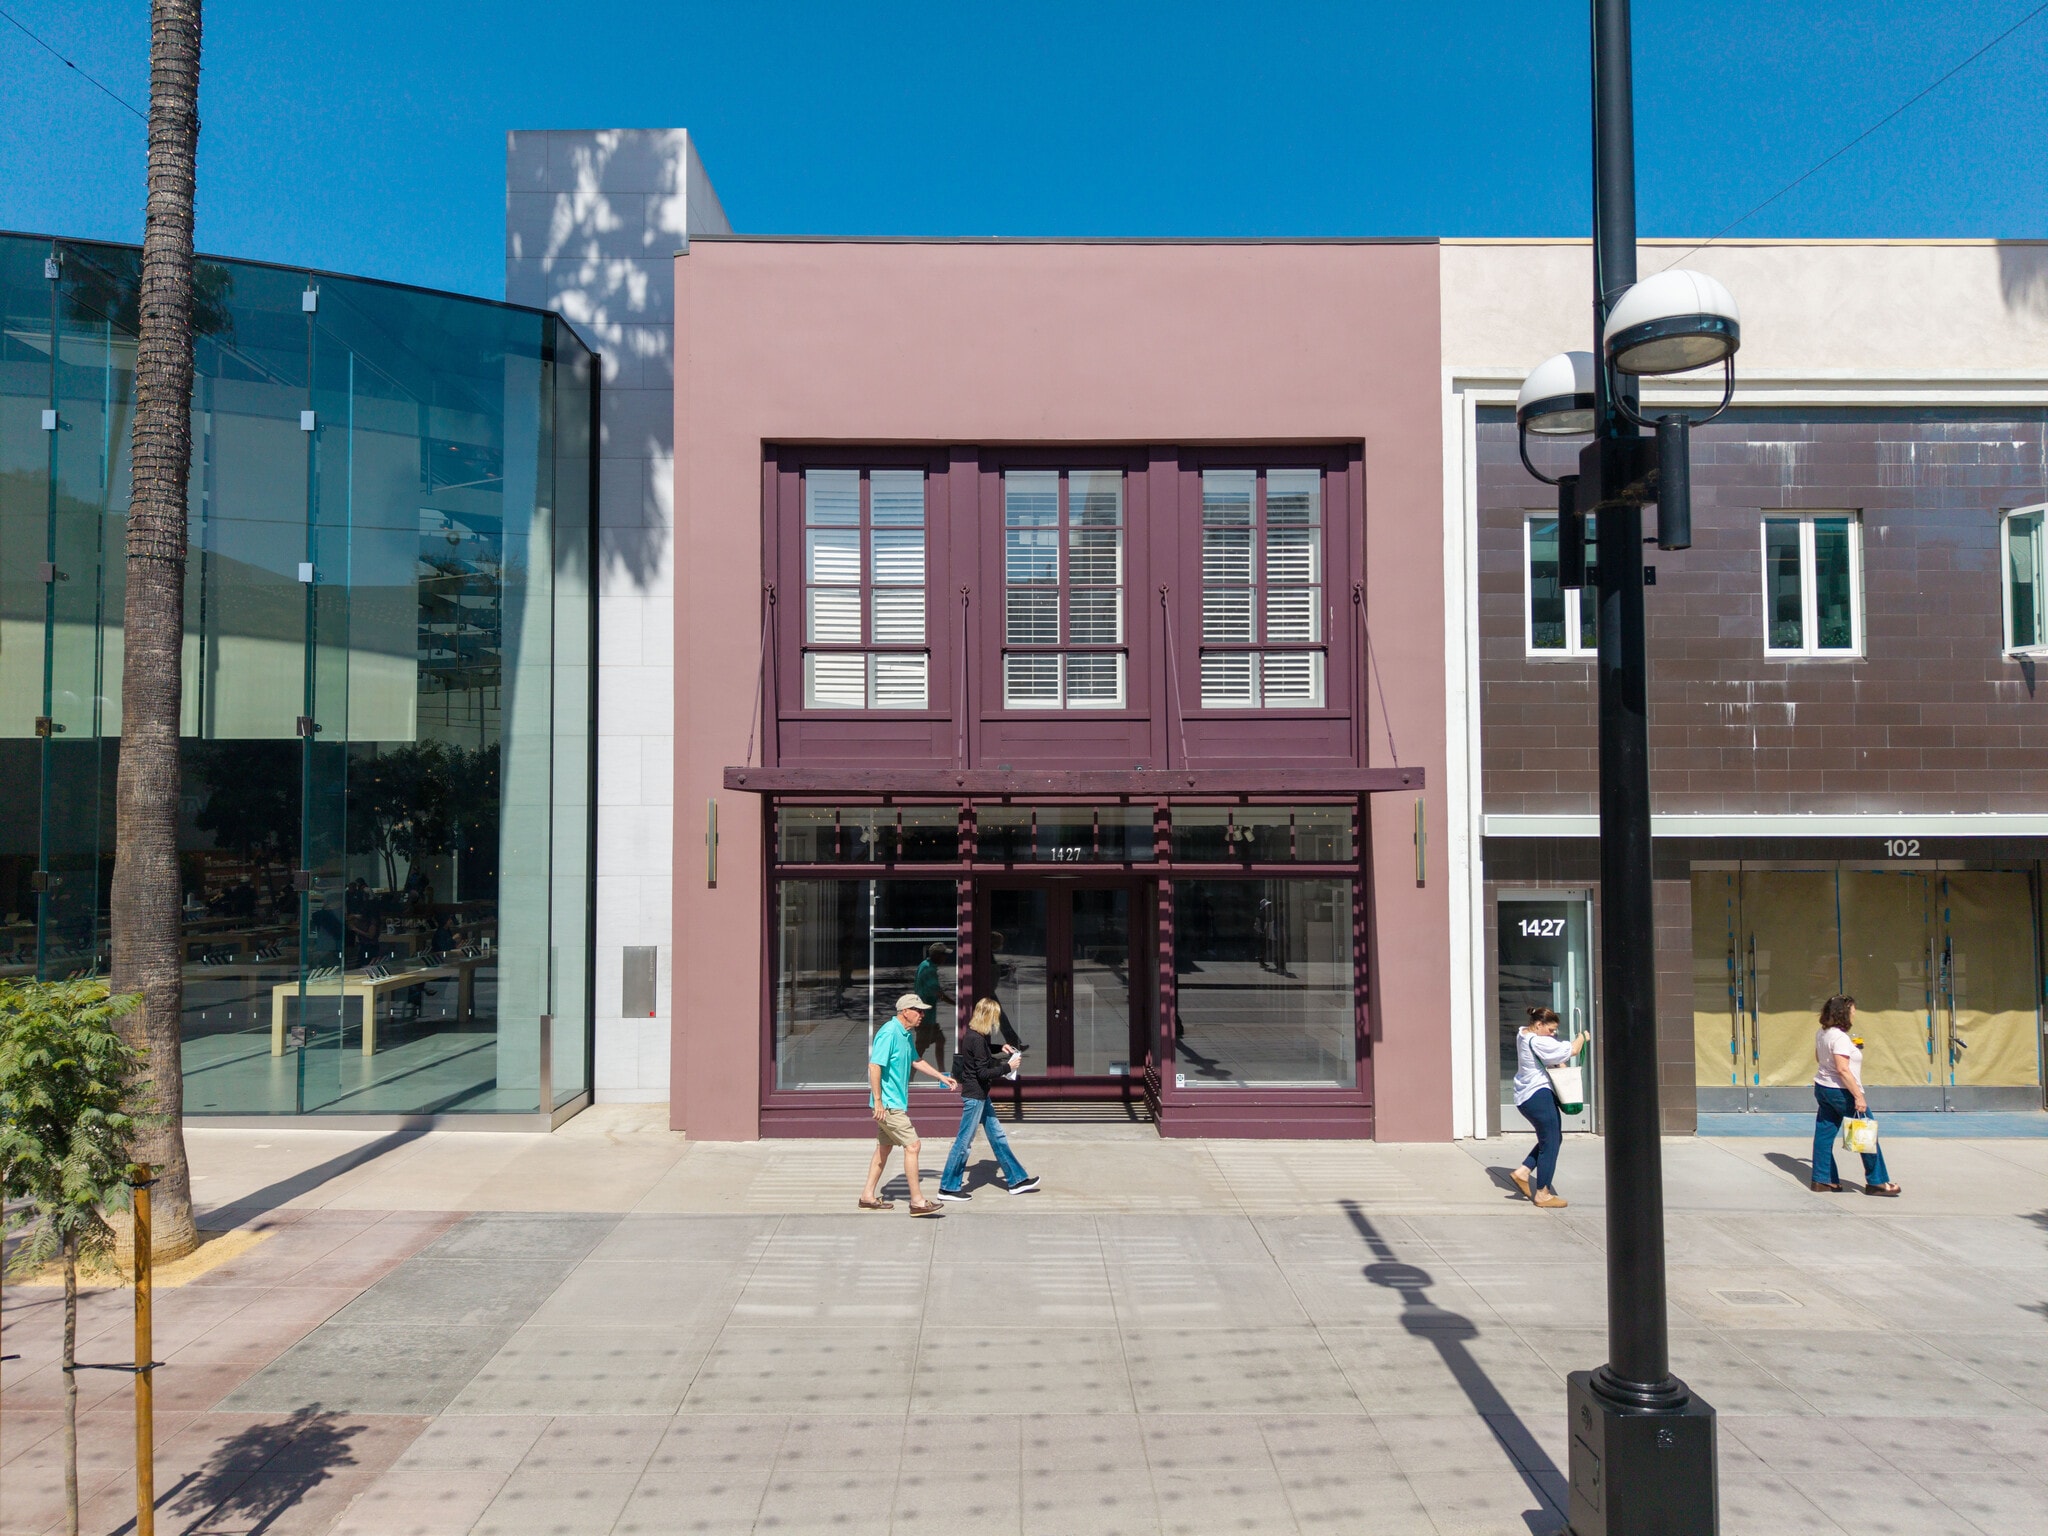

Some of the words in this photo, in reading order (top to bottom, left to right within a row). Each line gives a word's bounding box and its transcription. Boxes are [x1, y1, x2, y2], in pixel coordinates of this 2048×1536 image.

[1051, 847, 1081, 861] 1427
[1884, 839, 1920, 857] 102
[1518, 919, 1566, 937] 1427
